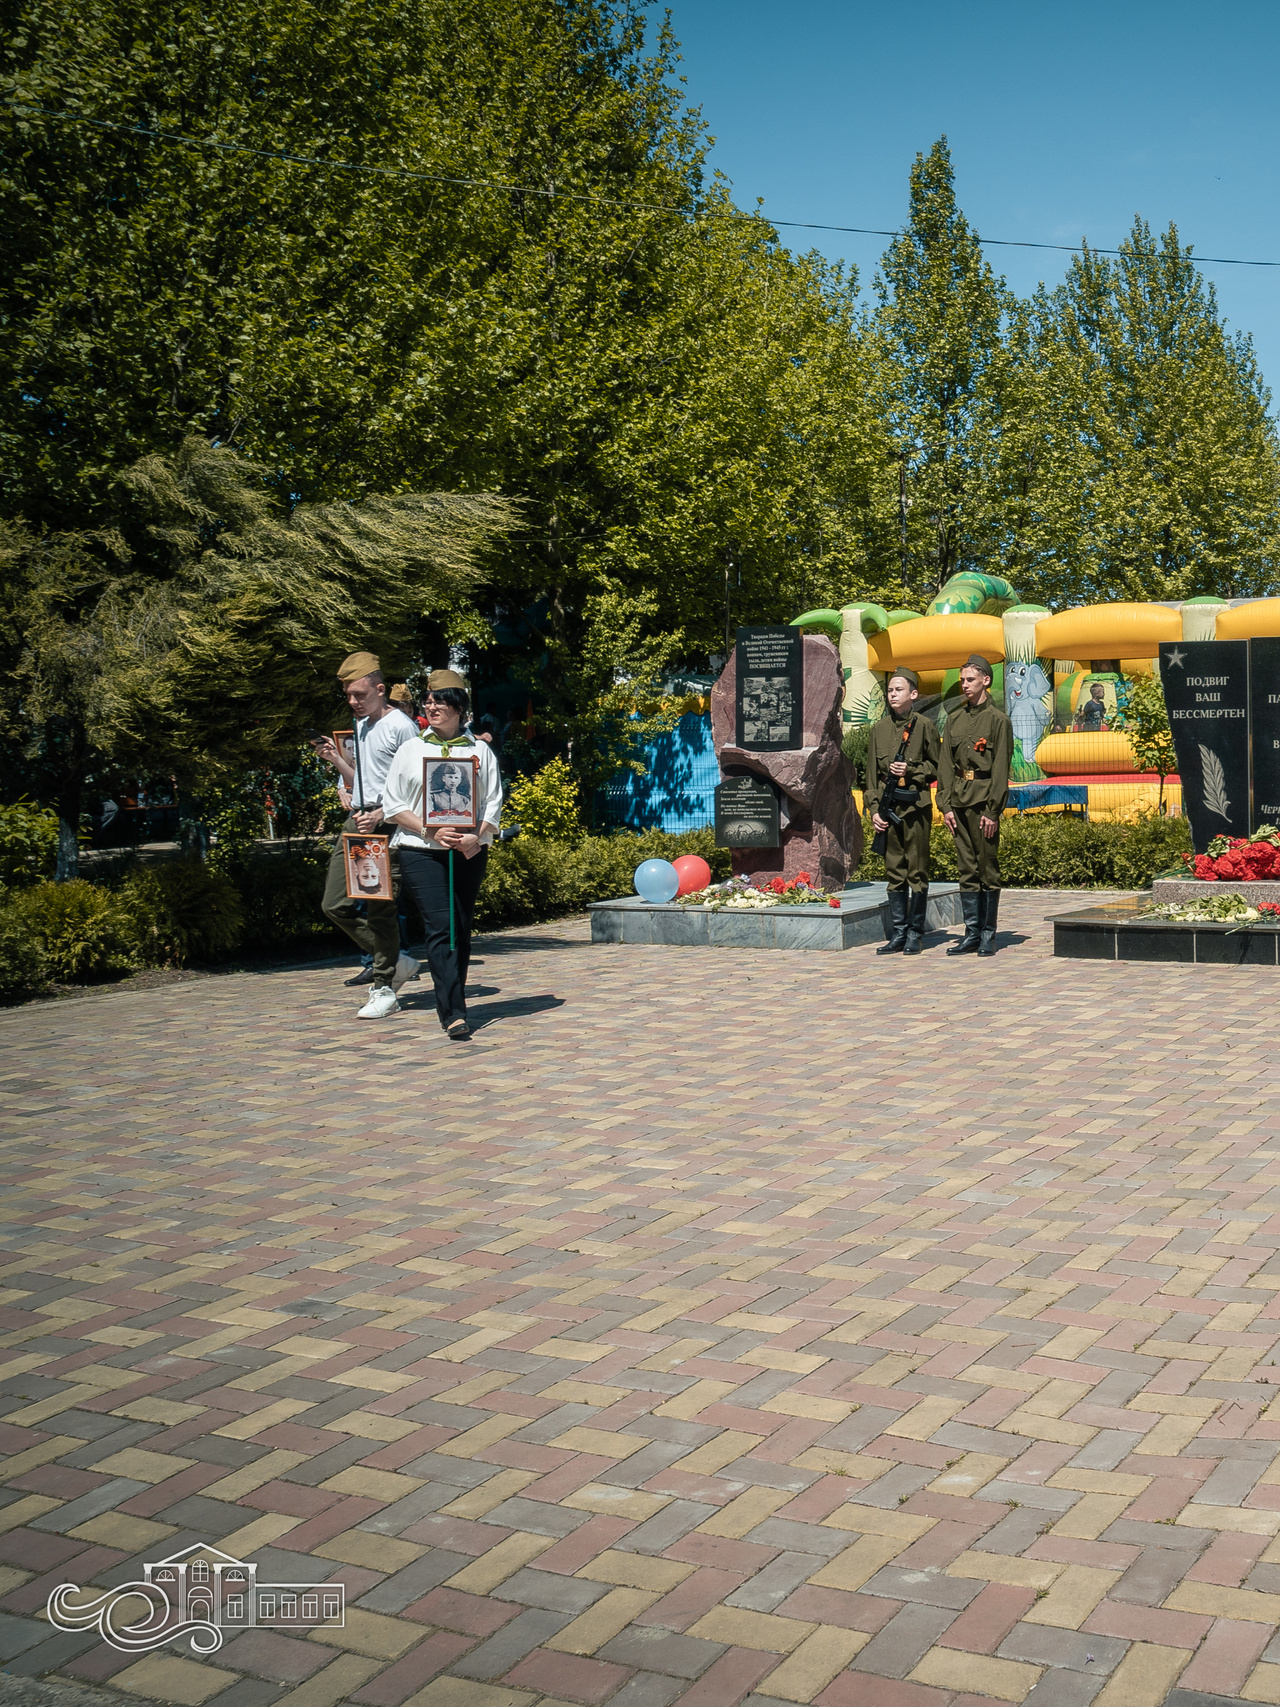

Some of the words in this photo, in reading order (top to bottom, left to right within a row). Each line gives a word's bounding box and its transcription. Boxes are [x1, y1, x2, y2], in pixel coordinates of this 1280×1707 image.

[1186, 676, 1230, 687] ПОДВИГ
[1195, 692, 1221, 702] ВАШ
[1172, 709, 1245, 719] БЕССМЕРТЕН
